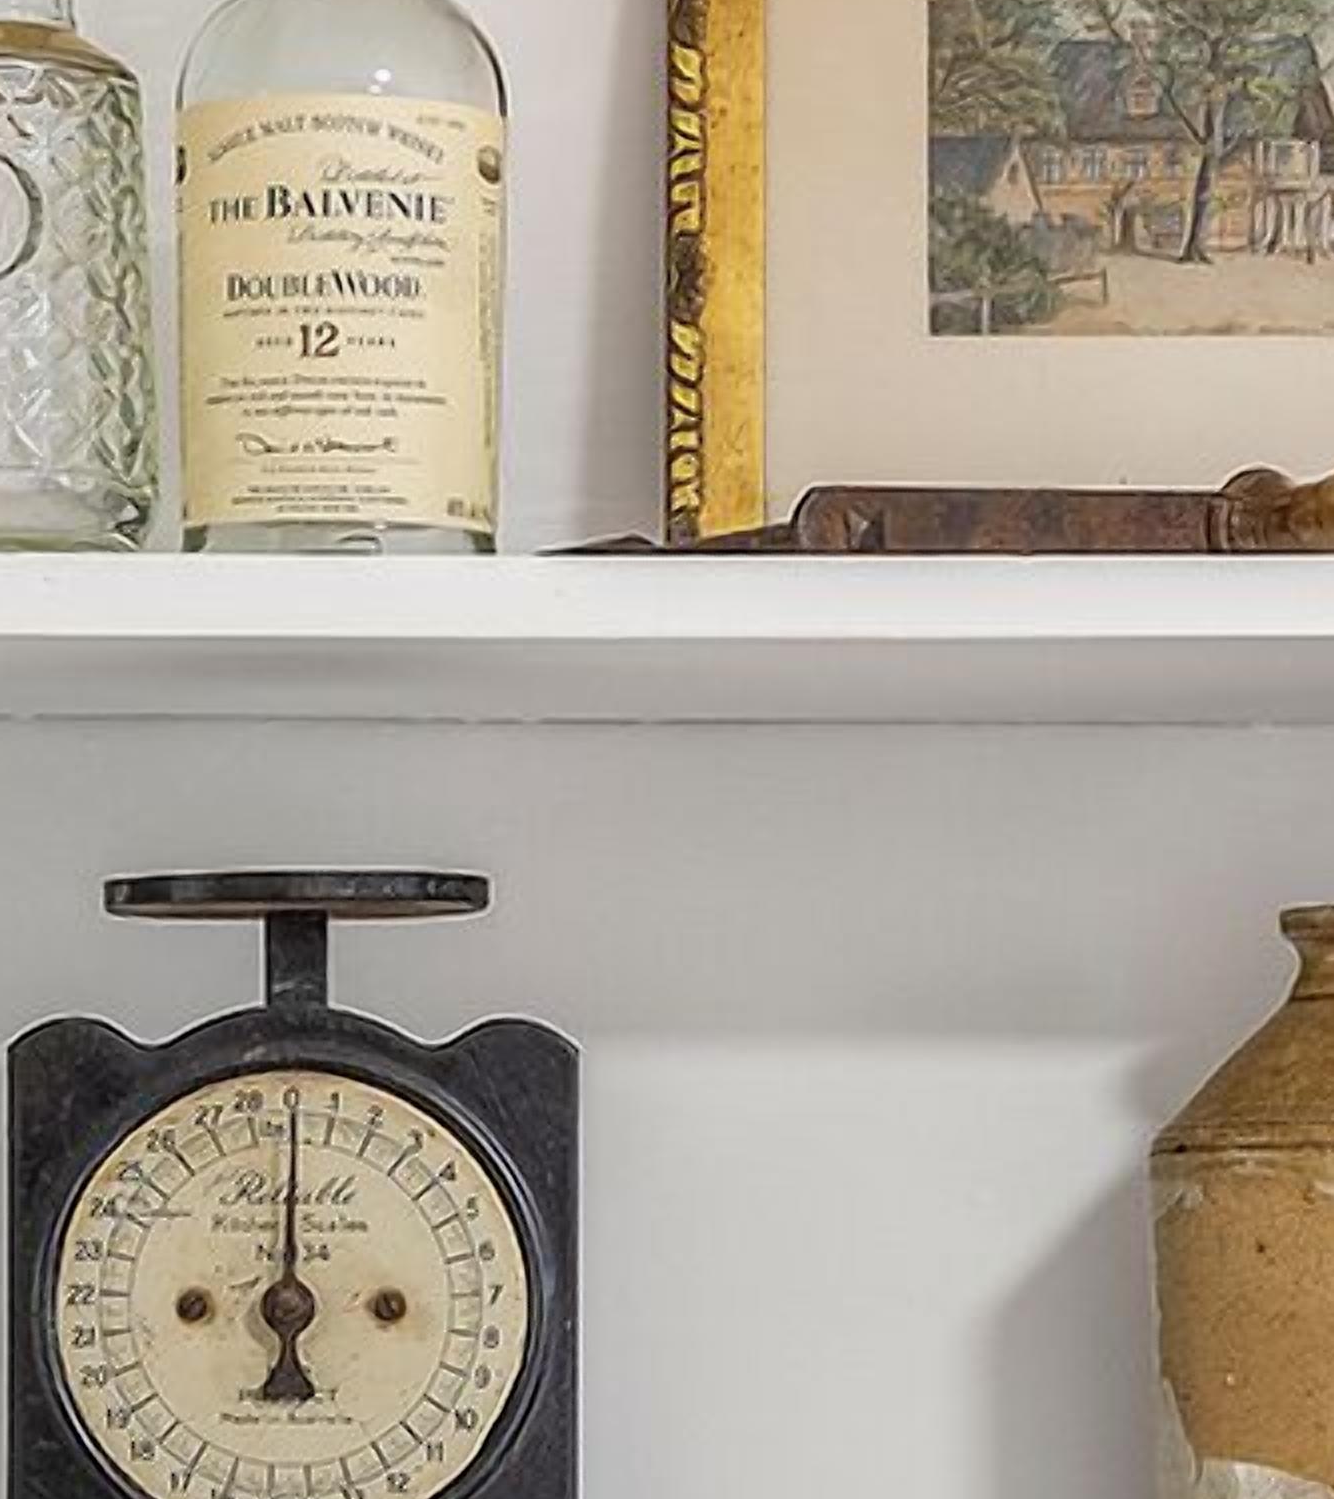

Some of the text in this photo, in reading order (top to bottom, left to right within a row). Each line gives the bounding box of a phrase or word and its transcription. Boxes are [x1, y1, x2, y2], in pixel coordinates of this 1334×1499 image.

[208, 195, 260, 224] THE
[266, 182, 451, 224] BALVENIE
[299, 320, 340, 359] 12
[67, 1285, 95, 1305] 22
[489, 1284, 504, 1305] 7
[71, 1325, 95, 1348] 21
[426, 1440, 444, 1462] 11
